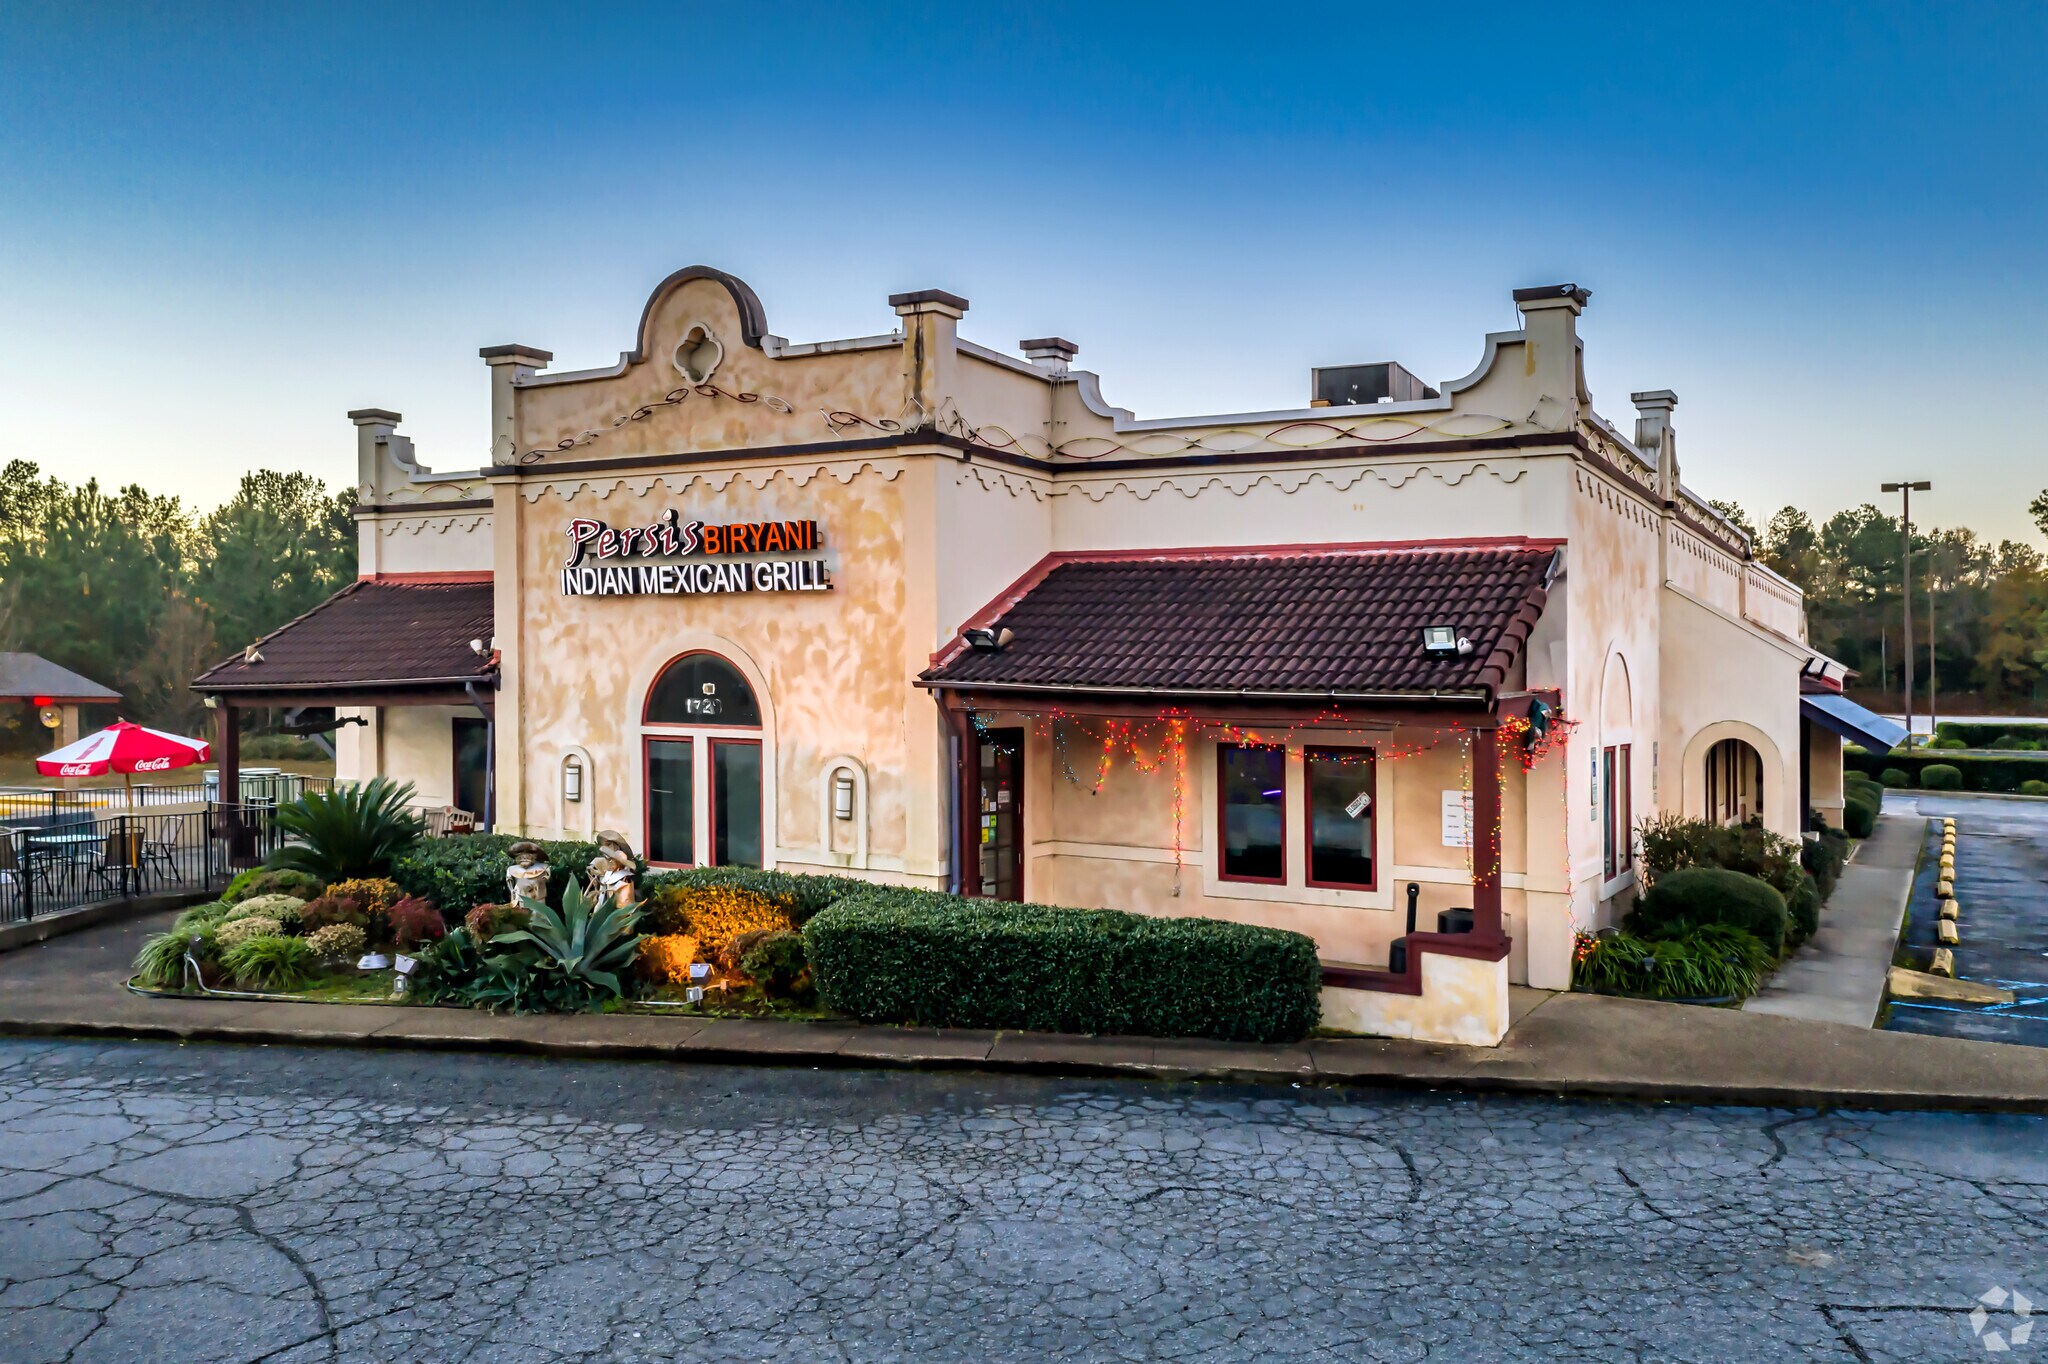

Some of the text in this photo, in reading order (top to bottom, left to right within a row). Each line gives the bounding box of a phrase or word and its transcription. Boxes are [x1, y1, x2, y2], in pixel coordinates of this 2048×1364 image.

[565, 508, 818, 567] Persis BIRYANI
[560, 560, 828, 595] INDIAN MEXICAN GRILL
